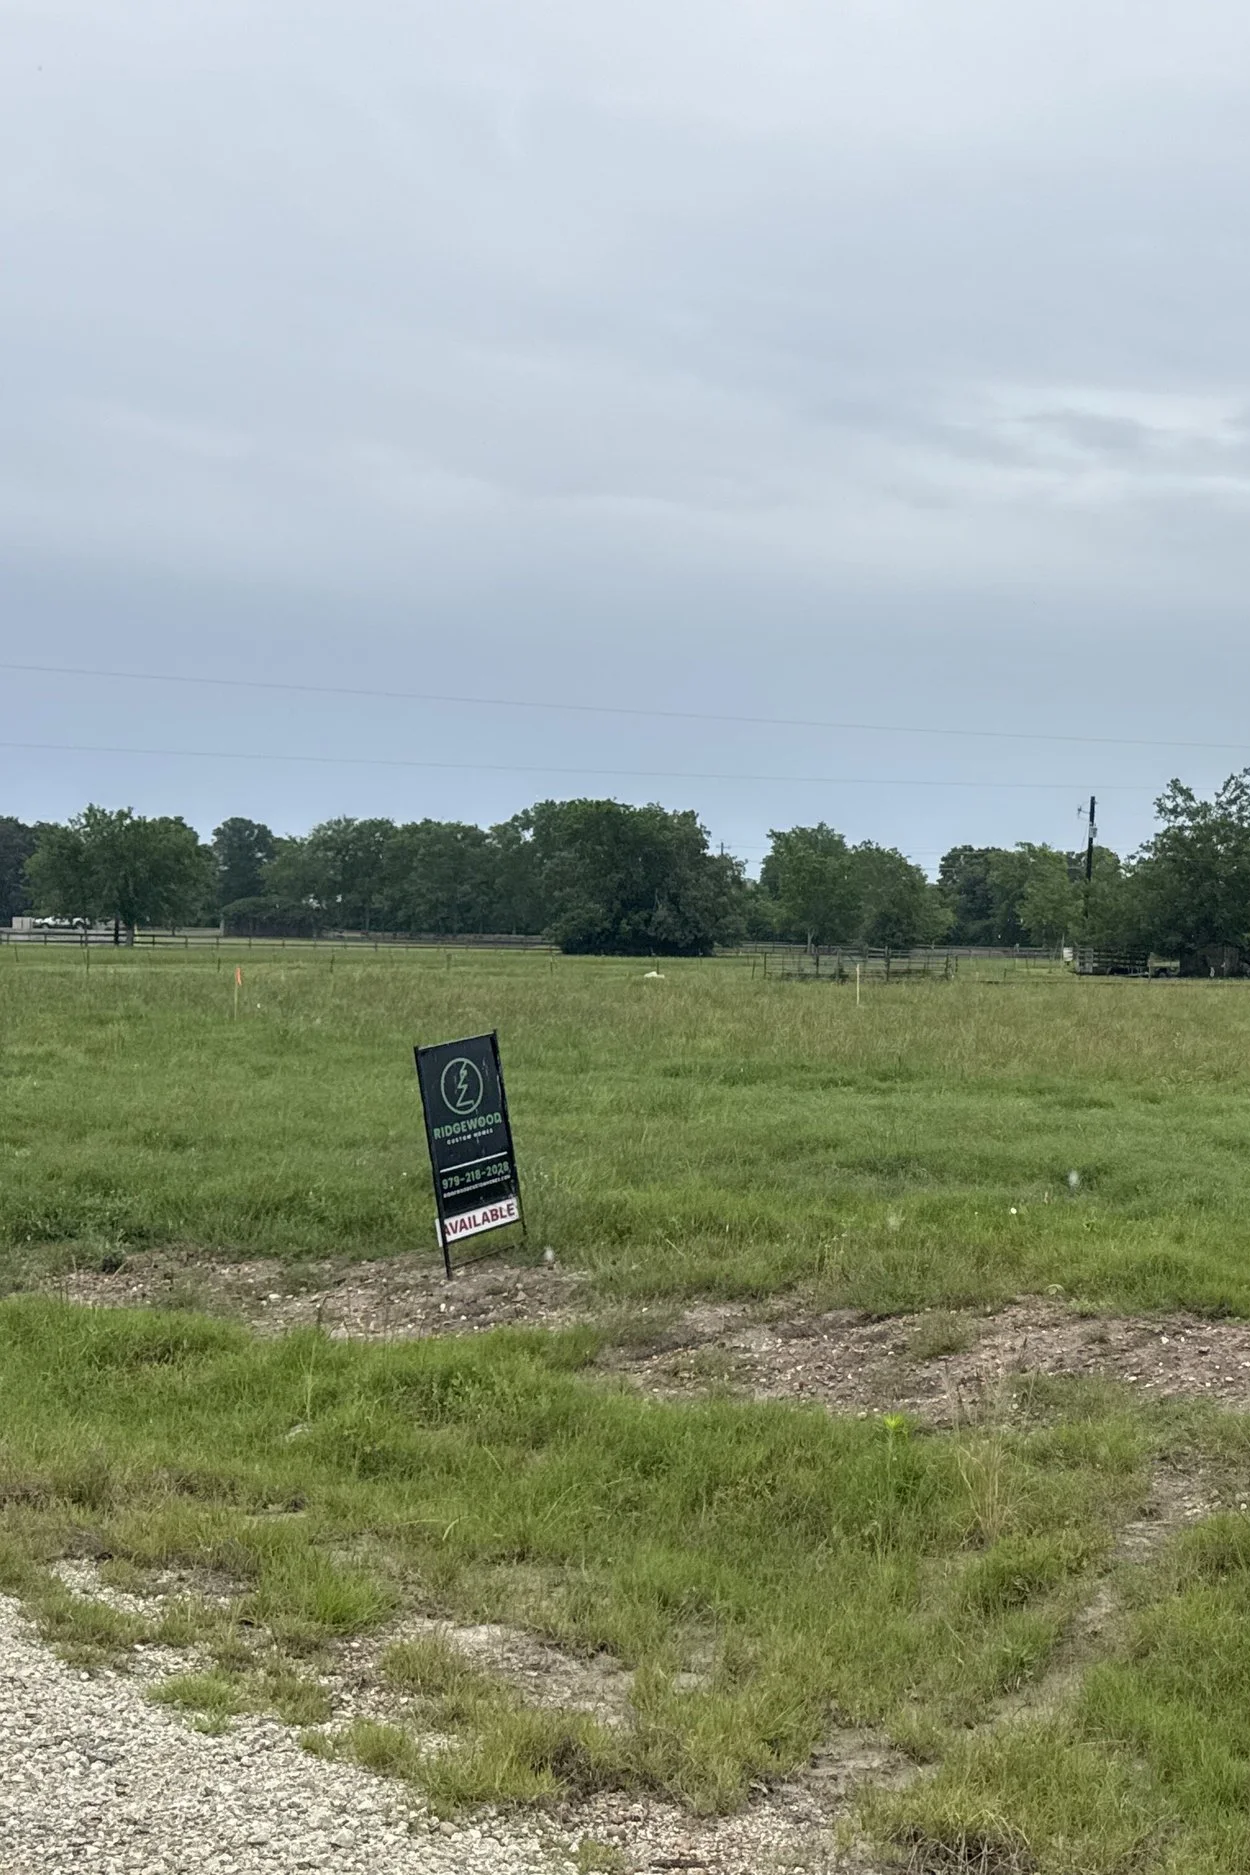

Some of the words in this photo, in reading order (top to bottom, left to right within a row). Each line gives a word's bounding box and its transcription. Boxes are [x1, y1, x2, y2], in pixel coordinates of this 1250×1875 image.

[433, 1112, 502, 1140] RIDGEWOOD
[442, 1161, 509, 1190] 979-218-2028
[443, 1203, 515, 1236] AVAILABLE
